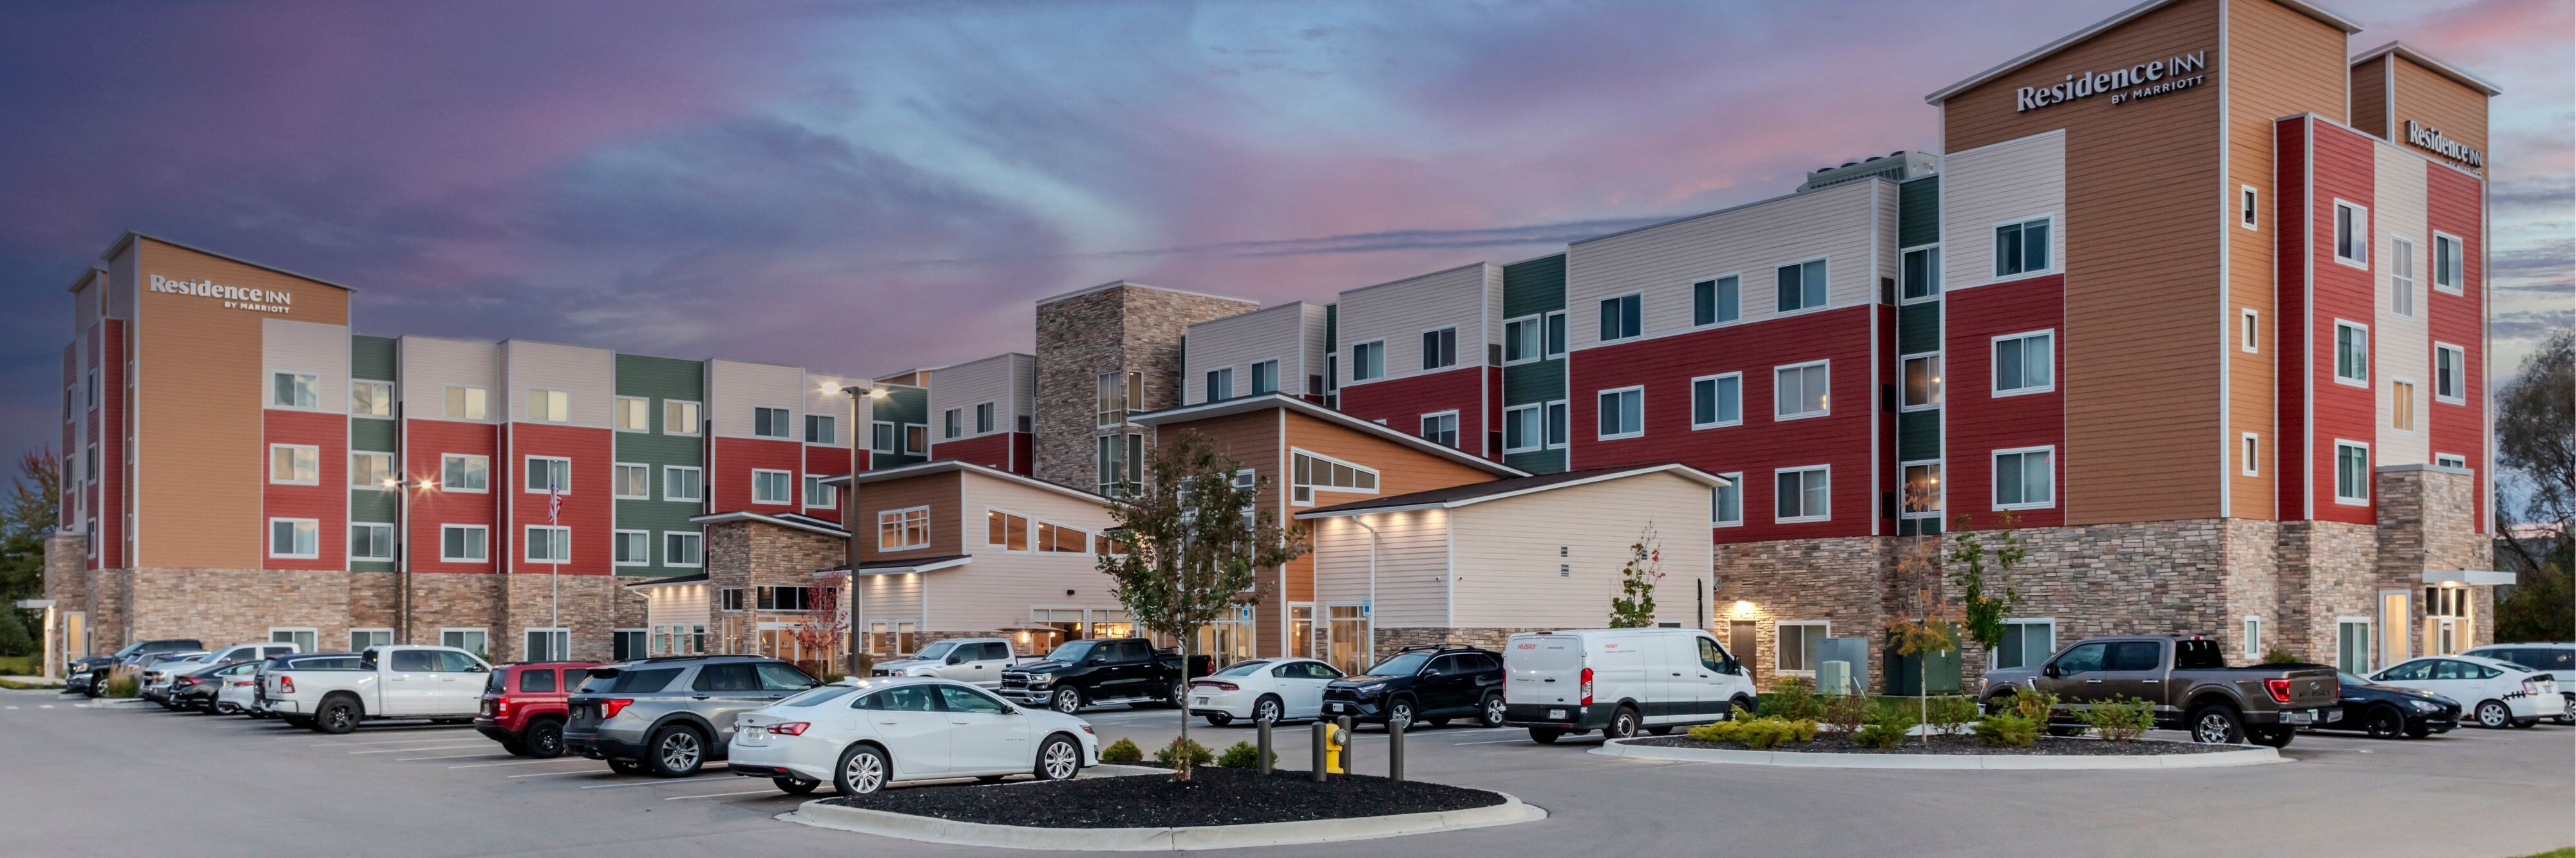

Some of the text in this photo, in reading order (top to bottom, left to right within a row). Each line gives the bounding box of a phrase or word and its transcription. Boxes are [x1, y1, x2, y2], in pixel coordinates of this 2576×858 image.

[2017, 50, 2205, 112] Residence INN
[2112, 75, 2204, 104] BY MARRIOTT
[2409, 120, 2482, 167] Residence INN
[150, 274, 290, 304] Residence INN
[240, 303, 290, 313] MARRIOTT
